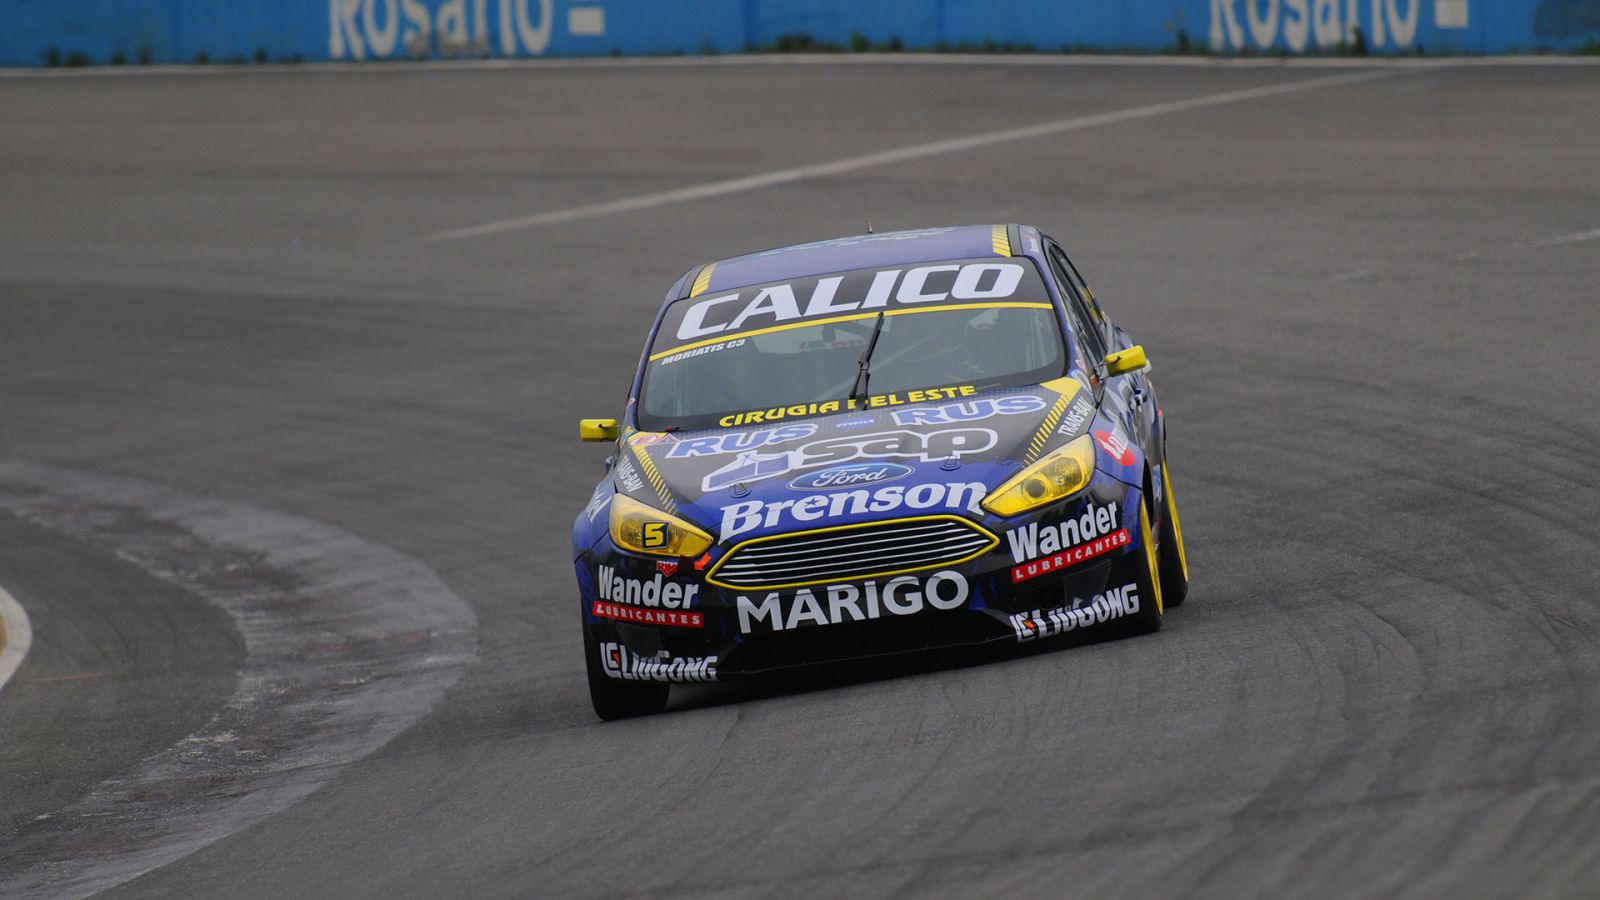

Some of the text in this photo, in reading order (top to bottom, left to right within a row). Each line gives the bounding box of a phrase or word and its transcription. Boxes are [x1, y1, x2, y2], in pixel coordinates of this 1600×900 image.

[677, 263, 1024, 340] CALICO
[661, 339, 746, 366] MORIATIS C3
[719, 400, 840, 427] CIRUGIA
[908, 385, 978, 402] ESTE
[890, 395, 1047, 426] RUS
[666, 423, 818, 458] RUS
[812, 467, 888, 487] Ford
[645, 523, 665, 546] 5
[718, 482, 987, 545] Brenson
[1007, 501, 1119, 564] Wander
[1012, 532, 1129, 579] LUBRICANTES
[599, 564, 700, 609] Wander
[737, 571, 969, 633] MARIGO
[597, 604, 701, 626] LUBRICANTES
